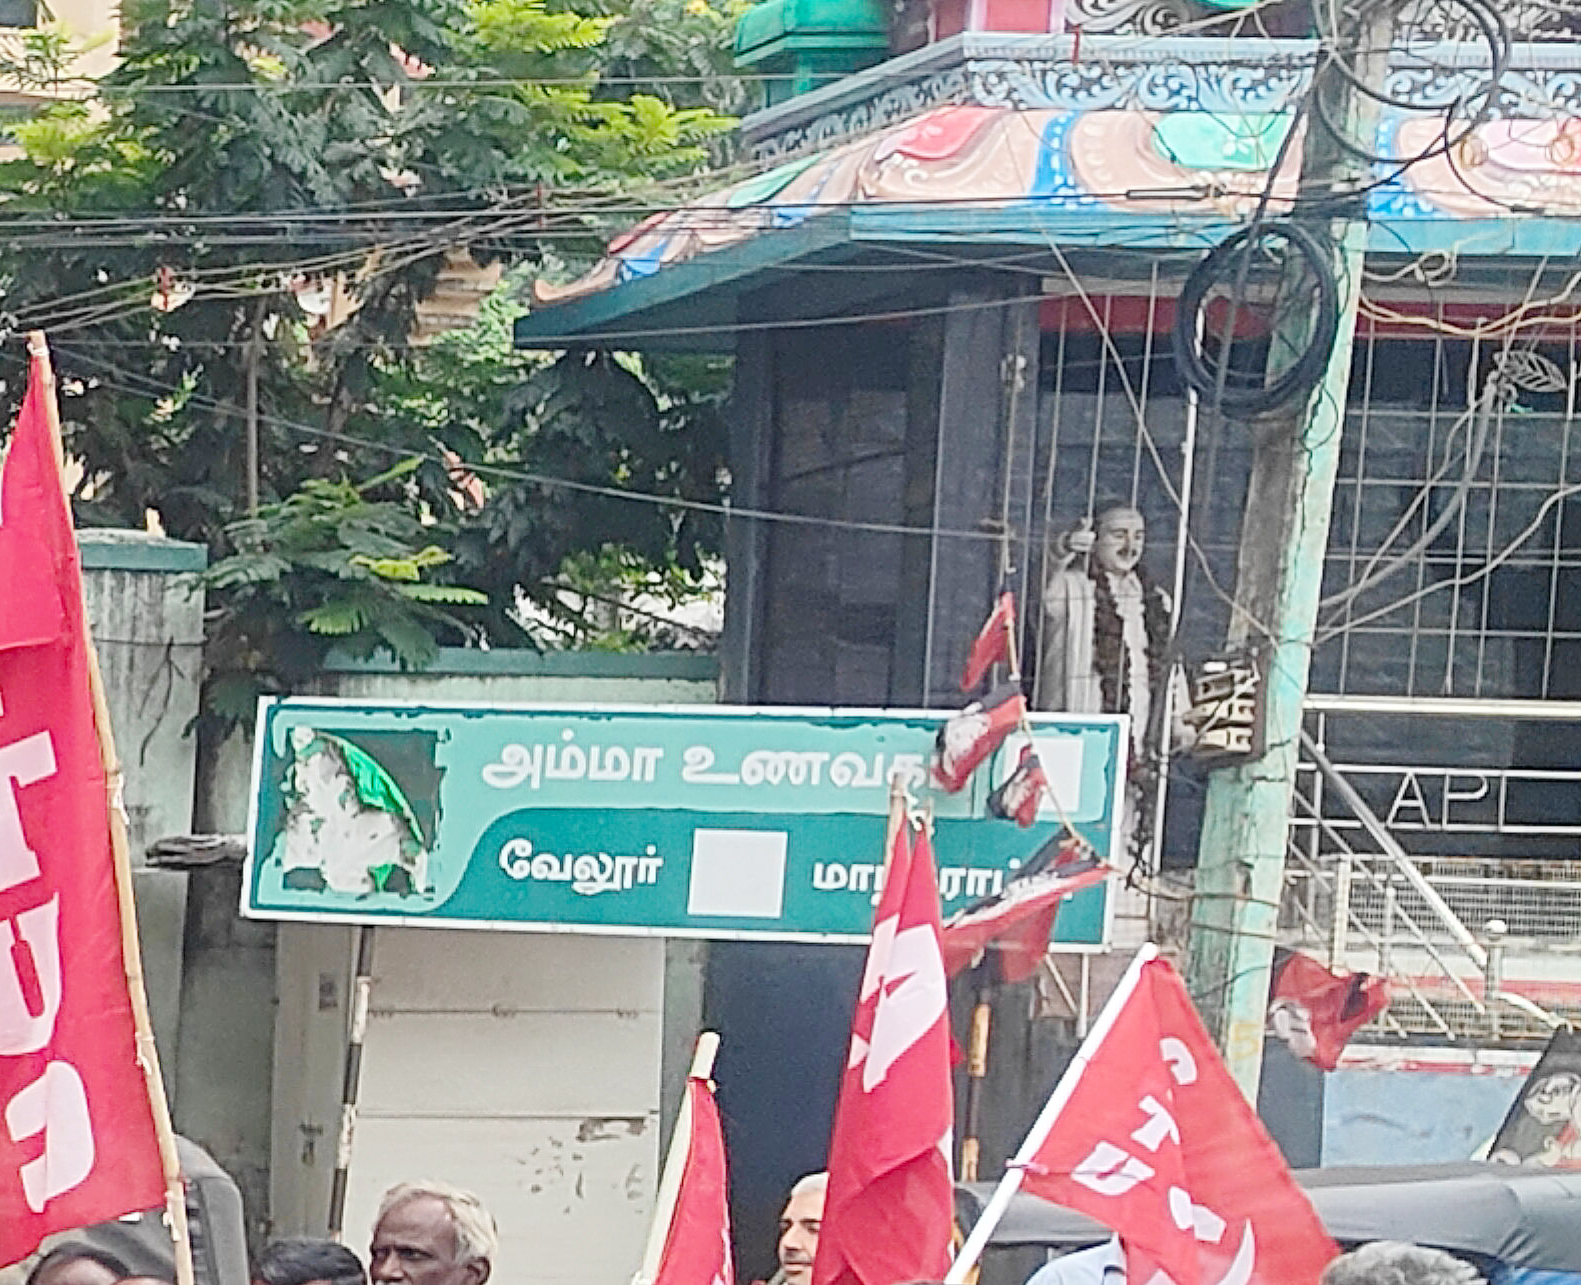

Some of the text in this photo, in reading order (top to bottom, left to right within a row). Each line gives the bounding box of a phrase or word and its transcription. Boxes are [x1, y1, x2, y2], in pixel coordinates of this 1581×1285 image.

[482, 730, 934, 792] அம்மா உணவக
[498, 832, 664, 898] வேலூர்
